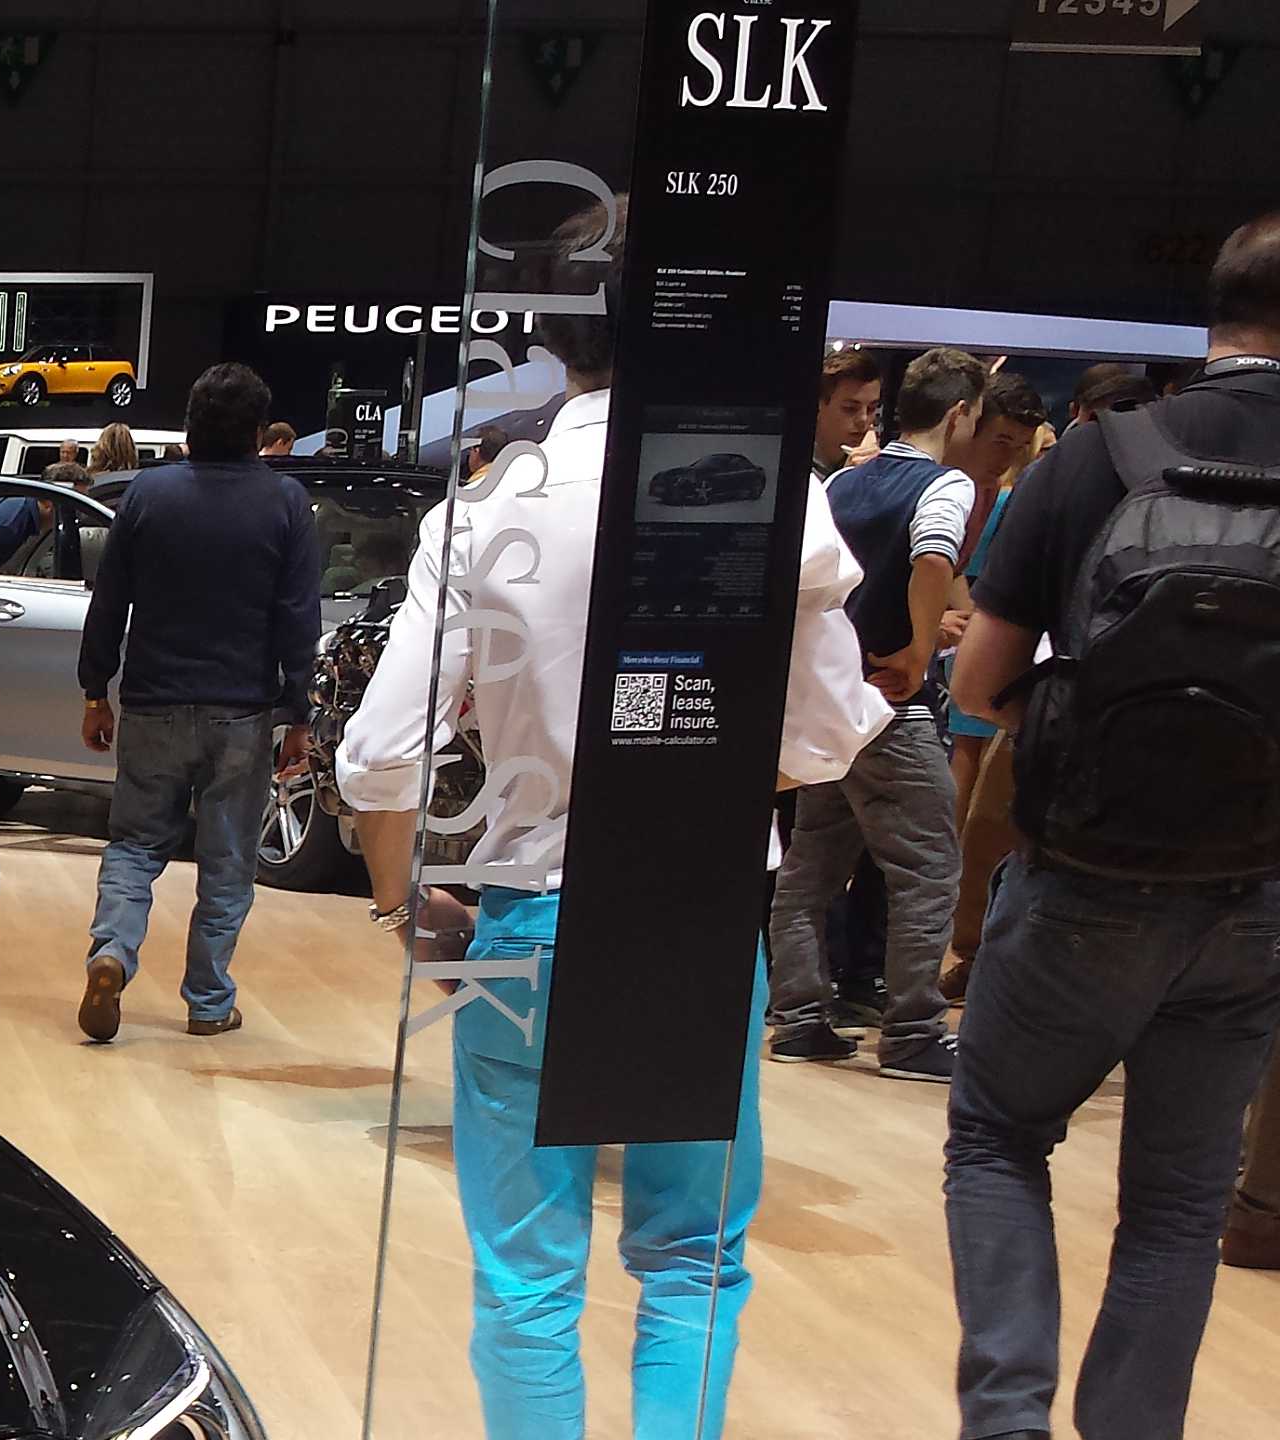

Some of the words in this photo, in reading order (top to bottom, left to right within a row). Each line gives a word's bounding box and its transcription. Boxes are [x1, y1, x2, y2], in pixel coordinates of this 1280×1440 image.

[681, 12, 832, 112] SLK
[666, 171, 701, 194] SLK
[707, 173, 738, 196] 250
[1235, 357, 1280, 370] LUMIX
[355, 404, 382, 421] CLA
[674, 674, 716, 693] Scan,
[672, 694, 715, 713] lease,
[670, 713, 719, 730] insure.
